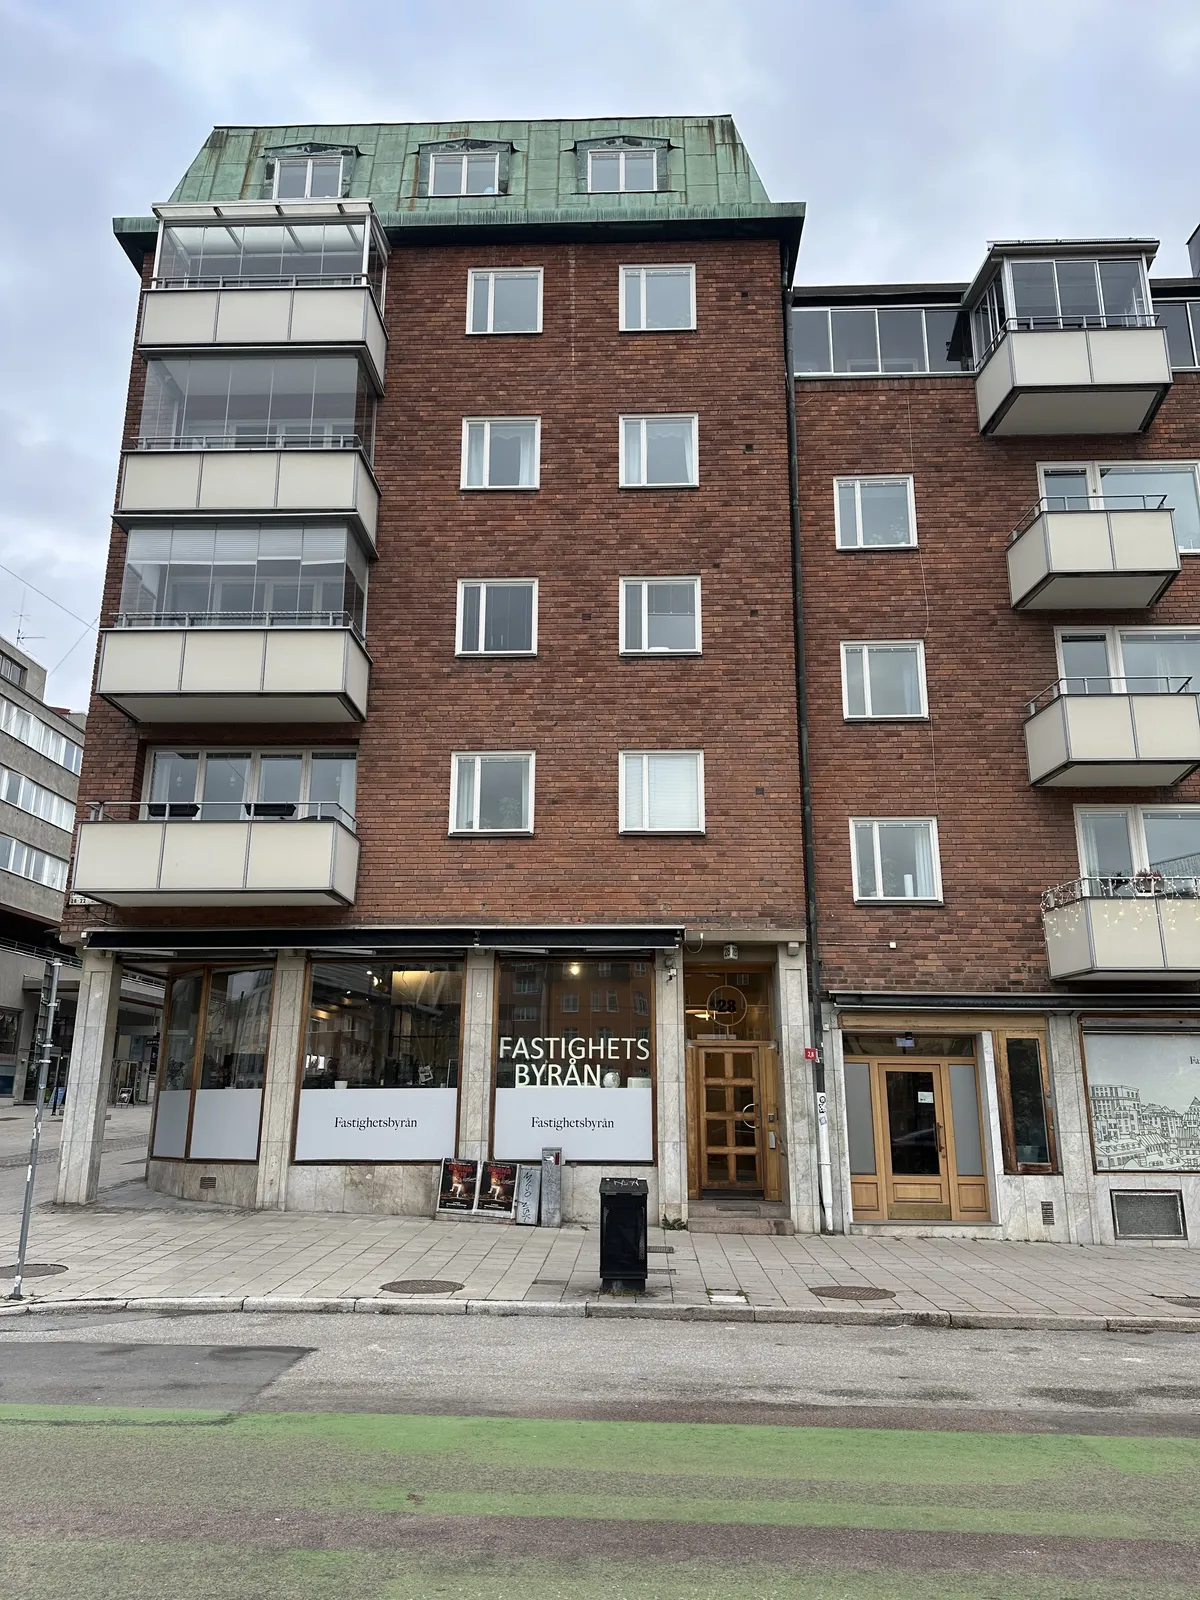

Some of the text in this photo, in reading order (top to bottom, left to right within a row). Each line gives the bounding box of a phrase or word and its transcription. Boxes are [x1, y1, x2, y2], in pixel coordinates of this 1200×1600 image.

[718, 999, 737, 1013] 28
[499, 1037, 650, 1060] FASTIGHETS
[515, 1058, 601, 1087] BYRÅN
[334, 1117, 418, 1131] Fastighetsbyrån
[531, 1117, 615, 1131] Fastighetsbyrån
